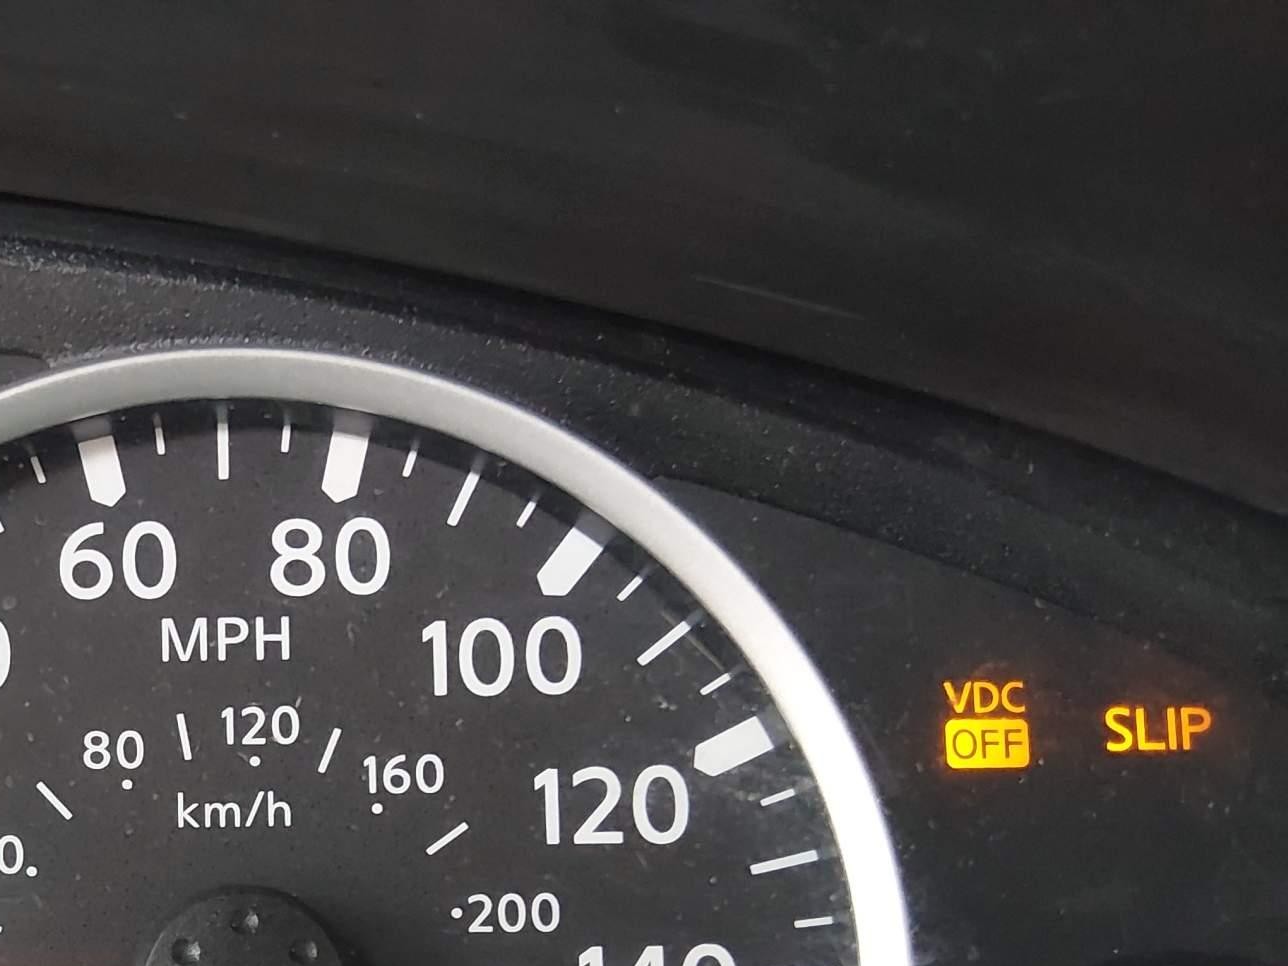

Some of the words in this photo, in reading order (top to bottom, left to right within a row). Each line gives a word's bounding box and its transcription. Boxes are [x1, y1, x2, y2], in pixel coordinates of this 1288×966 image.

[59, 521, 177, 600] 60
[269, 517, 391, 597] 80
[160, 616, 290, 662] MPH
[420, 616, 582, 697] 100
[943, 681, 1026, 714] VDC
[220, 706, 300, 745] 120
[952, 729, 1024, 759] OFF
[1105, 707, 1213, 752] SLIP
[82, 730, 144, 770] 80
[363, 754, 445, 794] 160
[176, 792, 292, 830] km/h
[533, 764, 690, 845] 120
[467, 893, 561, 934] 200
